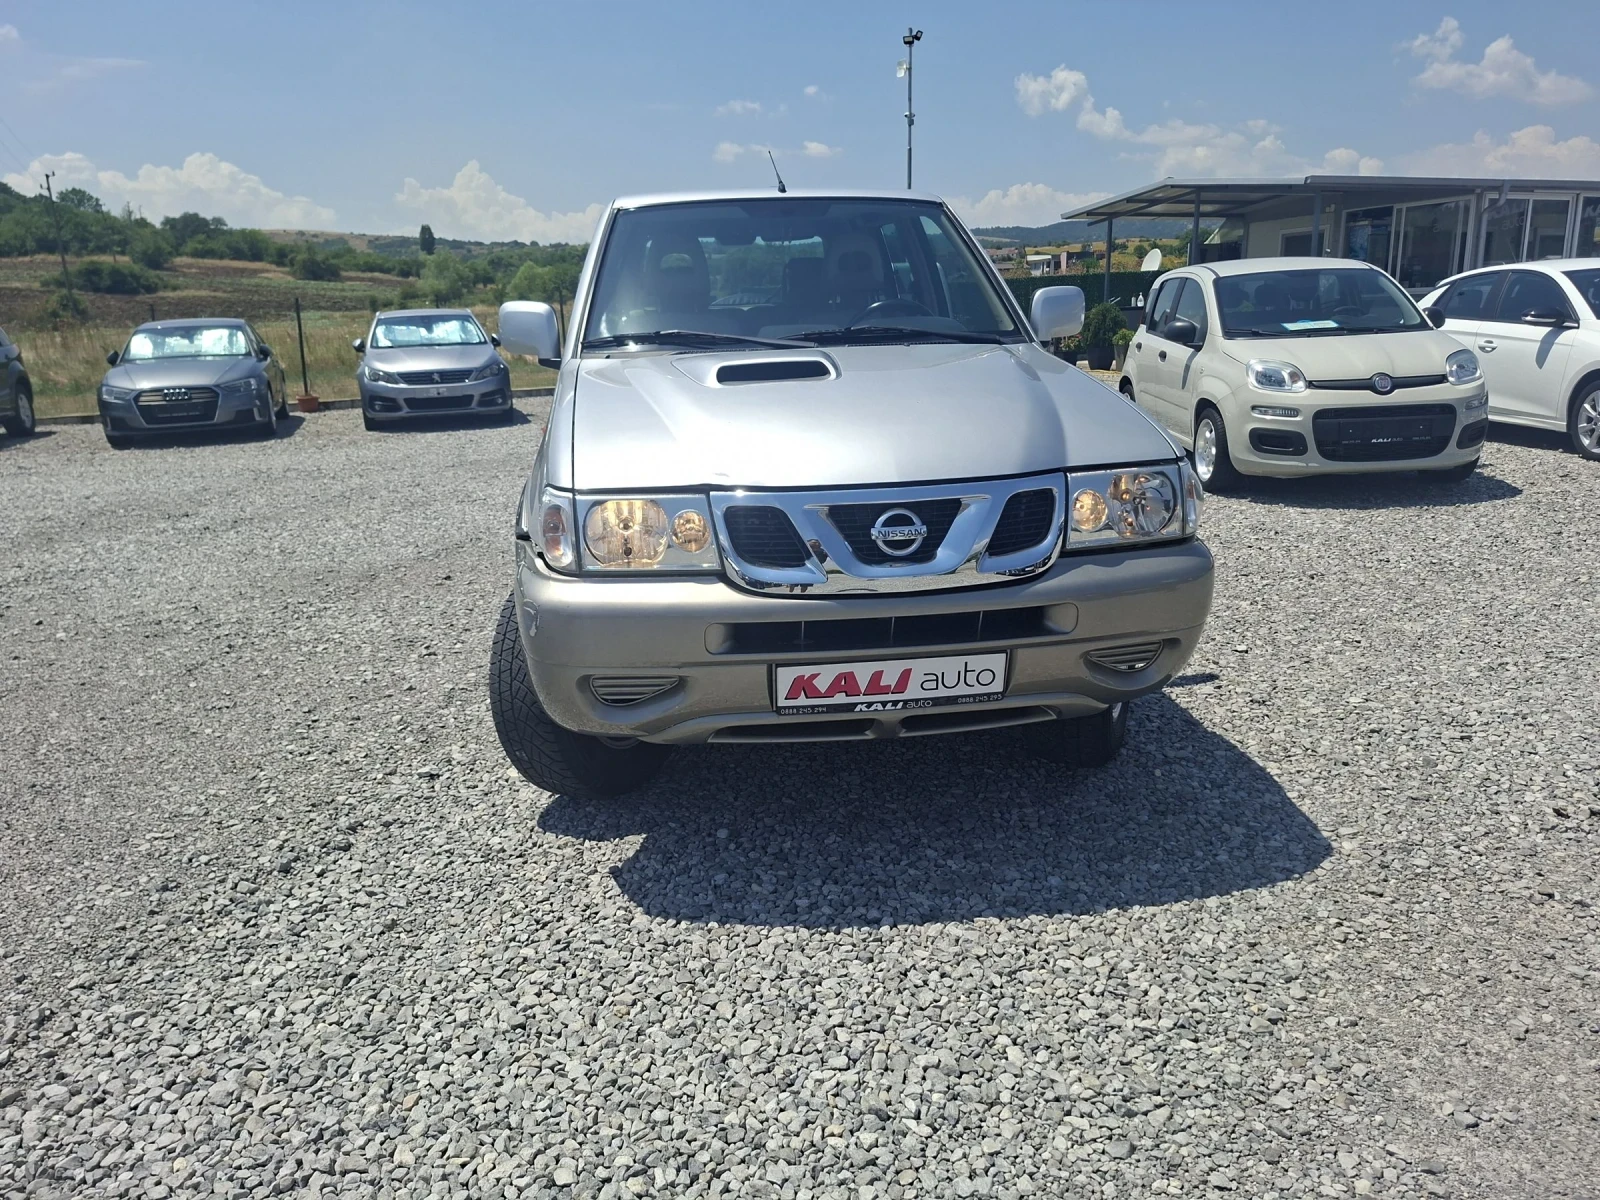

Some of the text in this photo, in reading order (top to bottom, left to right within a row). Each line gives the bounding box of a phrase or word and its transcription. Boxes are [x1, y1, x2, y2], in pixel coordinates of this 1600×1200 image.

[877, 528, 922, 538] NISSAN
[784, 661, 996, 700] KALI auto
[853, 699, 932, 712] KALI auto
